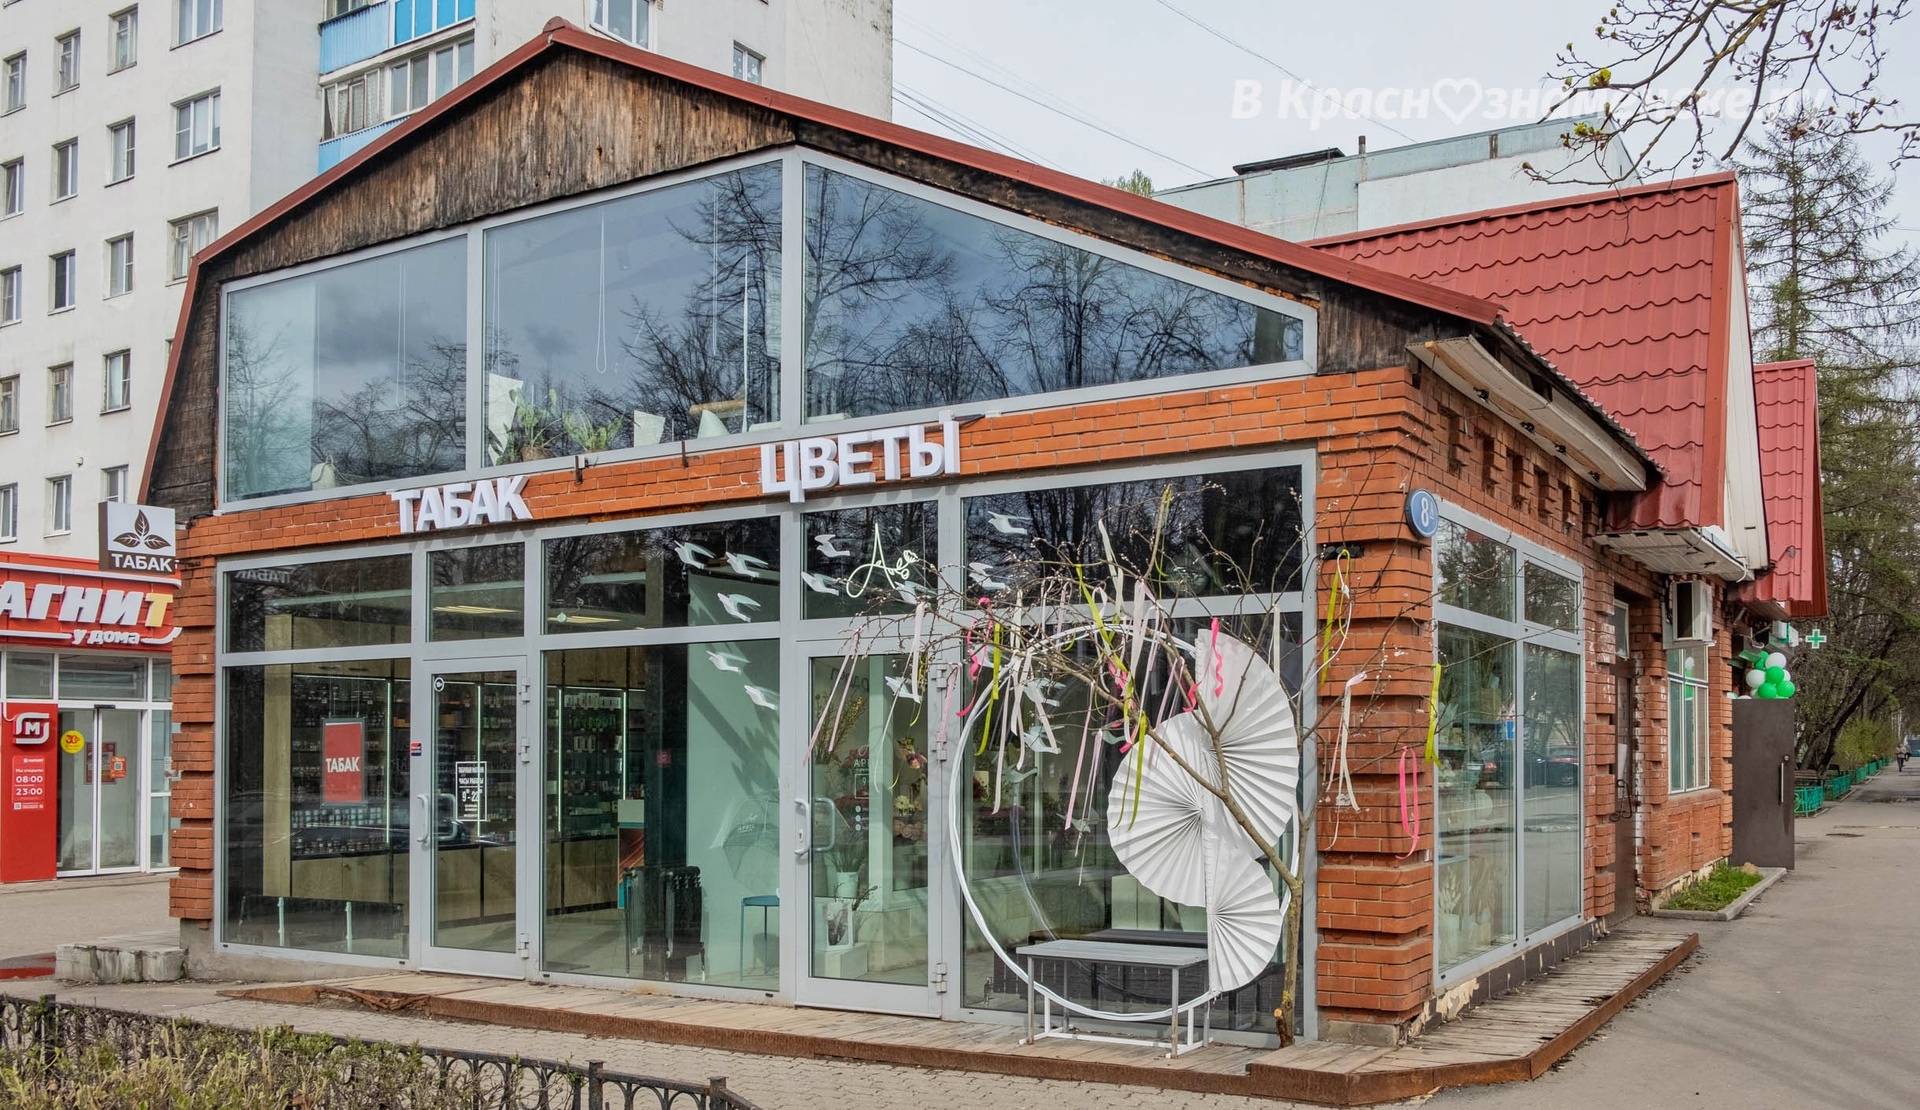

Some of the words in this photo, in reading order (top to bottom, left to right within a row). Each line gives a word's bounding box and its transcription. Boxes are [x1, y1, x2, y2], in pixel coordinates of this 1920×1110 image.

[761, 421, 960, 503] ЦВЕТЫ
[389, 475, 533, 533] ТАБАК
[111, 553, 173, 572] ТАБАК
[0, 580, 174, 628] АГНИТ
[73, 629, 87, 645] у
[87, 630, 140, 645] дома
[326, 757, 360, 773] ТАБАК
[15, 775, 43, 783] 08:00
[15, 787, 43, 795] 23:00
